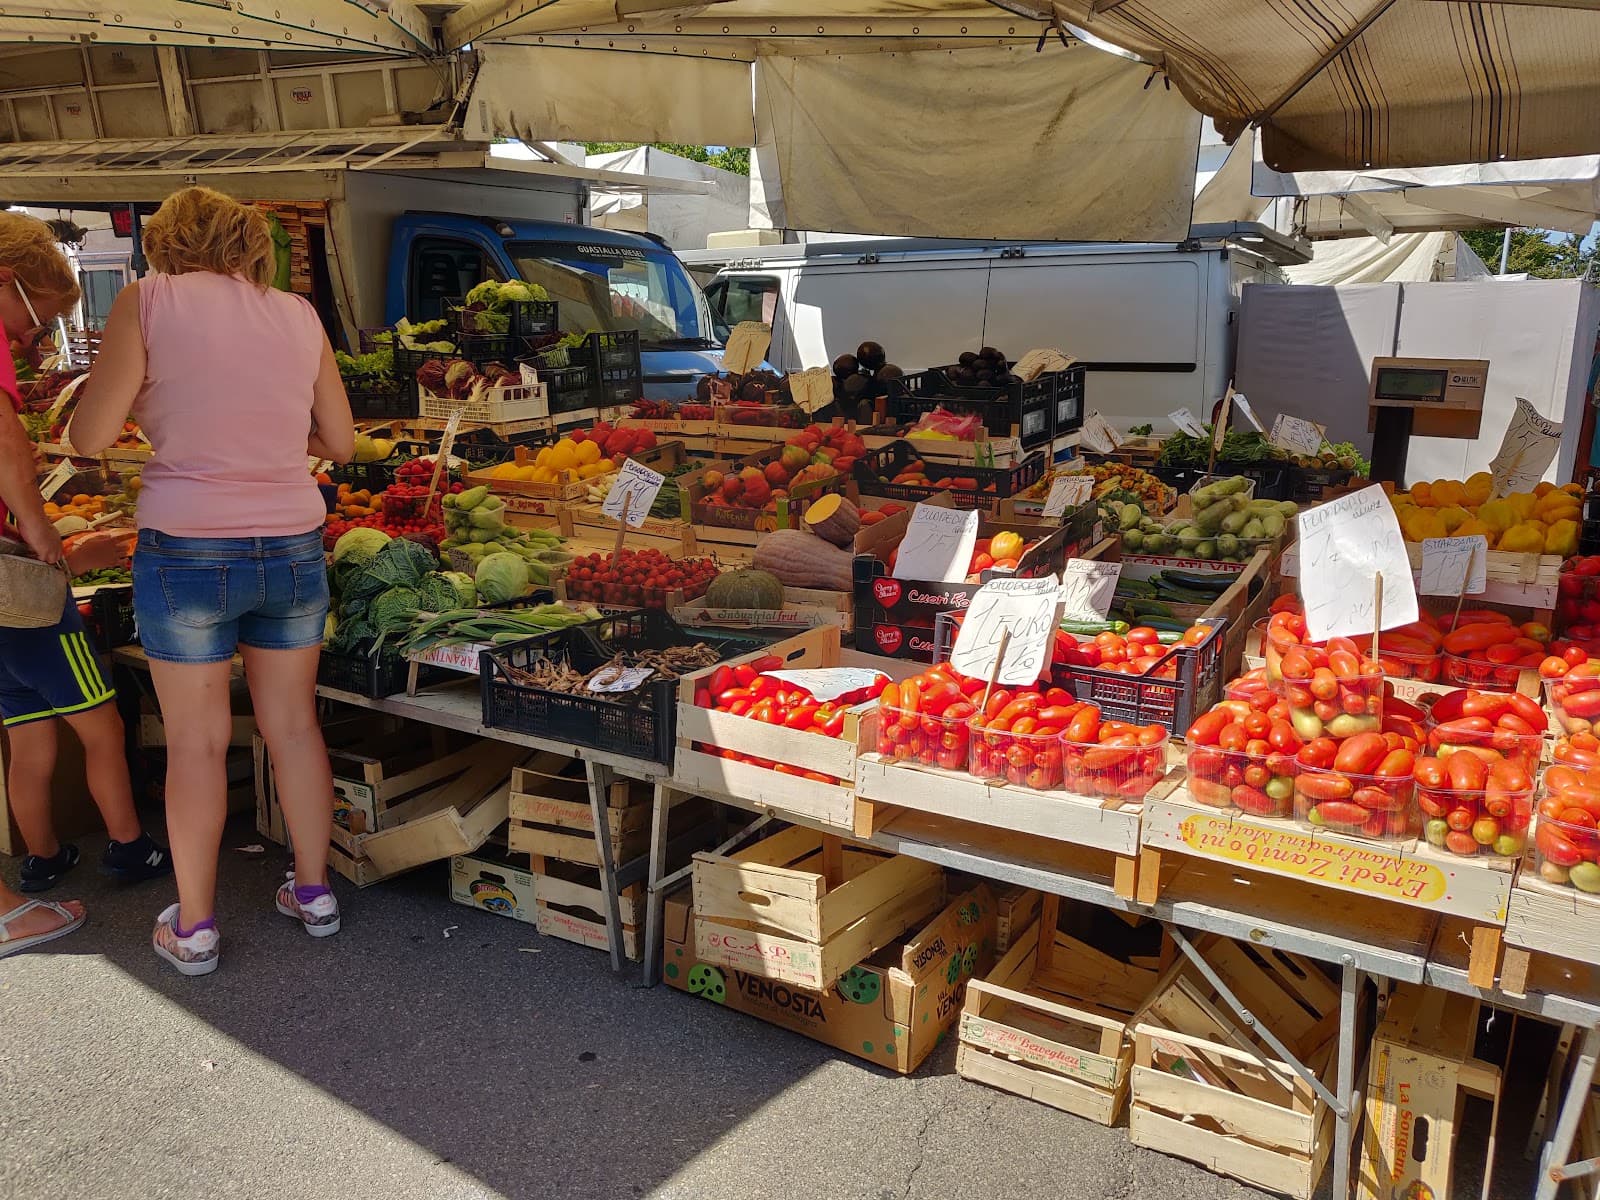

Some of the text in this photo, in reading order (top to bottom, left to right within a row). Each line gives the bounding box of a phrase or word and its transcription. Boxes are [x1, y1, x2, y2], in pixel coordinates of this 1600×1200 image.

[577, 245, 621, 256] GUASTALLA
[620, 248, 646, 258] DIESEL
[908, 589, 949, 605] Cuori
[717, 610, 798, 624] Industrial frut
[1207, 819, 1273, 846] Matteo
[146, 850, 164, 867] N
[1199, 832, 1332, 878] Zaniboni
[1278, 833, 1404, 874] Manfredini
[1338, 863, 1430, 899] Eredi
[1407, 862, 1428, 877] di
[723, 935, 791, 960] C.A.P.
[912, 936, 946, 970] VENOSTA
[734, 969, 827, 1023] VENOSTA
[936, 981, 967, 1021] VENO
[1398, 1081, 1412, 1106] La
[1391, 1109, 1414, 1182] Sorgente
